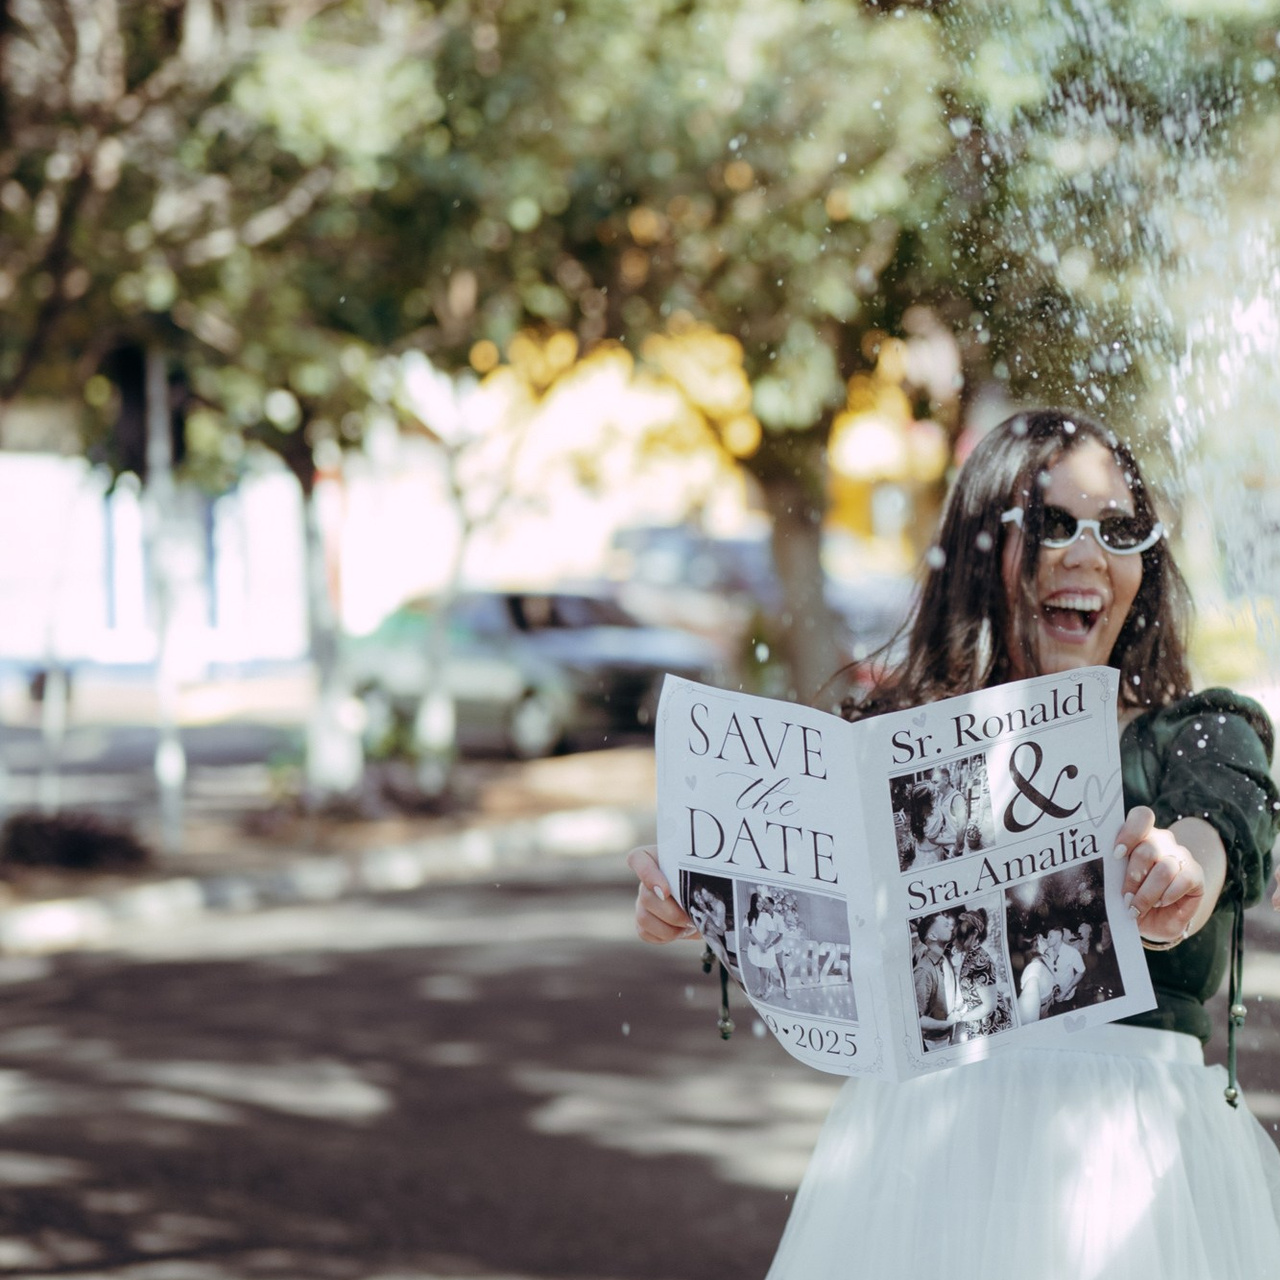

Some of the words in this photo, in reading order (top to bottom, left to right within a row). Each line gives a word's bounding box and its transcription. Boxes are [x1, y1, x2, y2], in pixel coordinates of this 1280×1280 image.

[689, 703, 827, 780] SAVE
[891, 730, 942, 765] Sr.
[951, 683, 1086, 748] Ronald
[716, 772, 800, 816] the
[1004, 741, 1083, 833] &
[686, 807, 838, 884] DATE
[907, 880, 969, 911] Sra.
[973, 828, 1100, 893] Amalia
[792, 1024, 858, 1057] 2025
